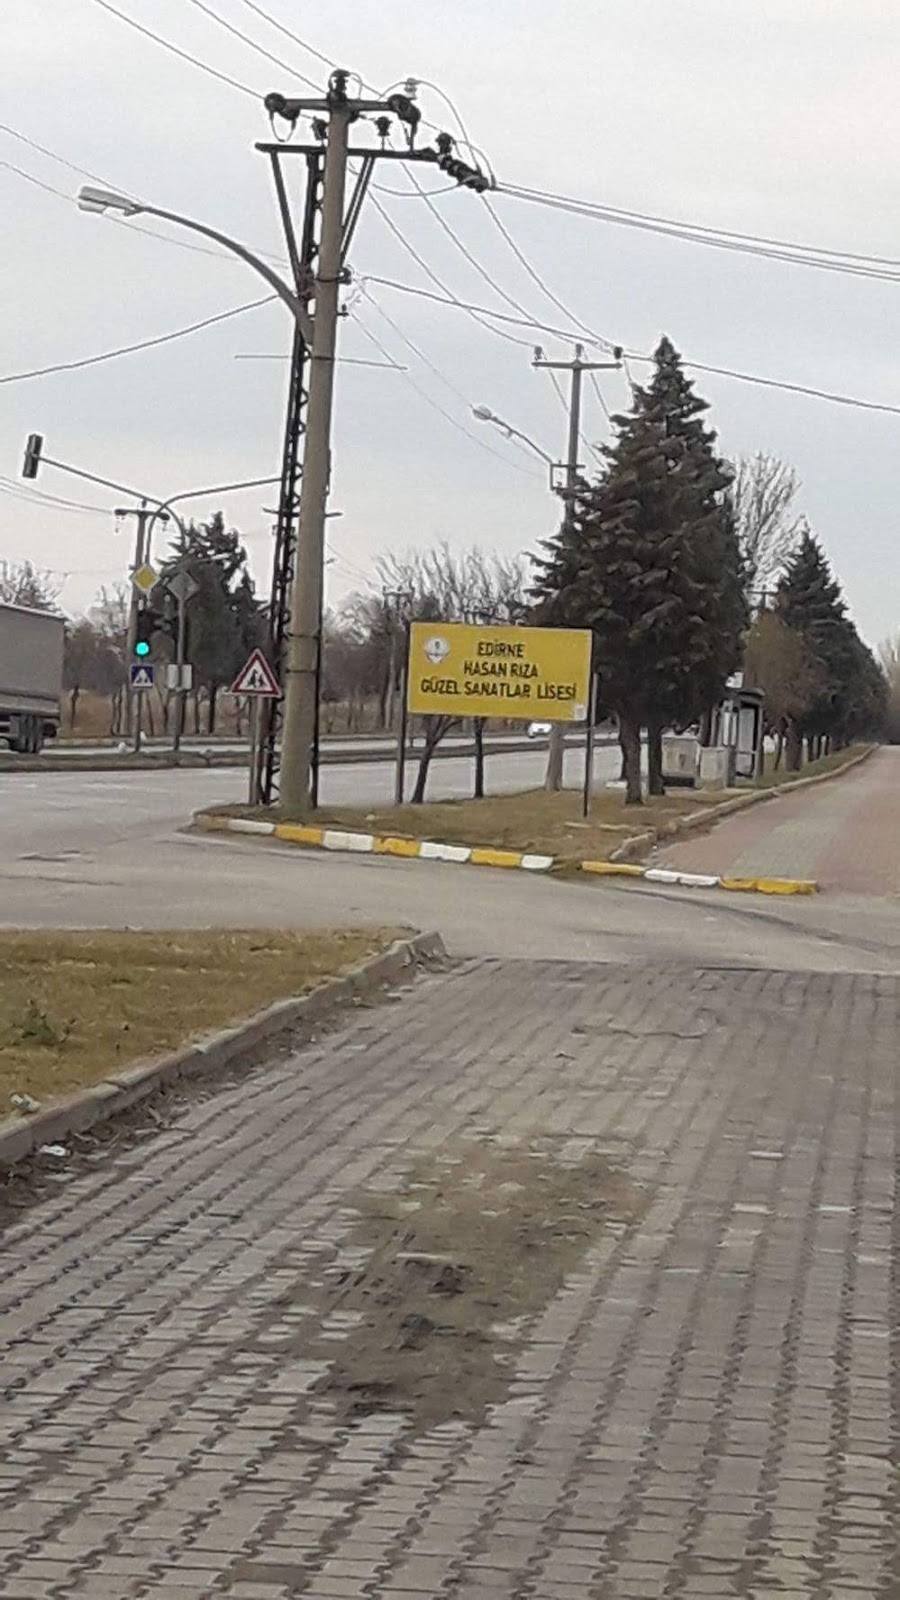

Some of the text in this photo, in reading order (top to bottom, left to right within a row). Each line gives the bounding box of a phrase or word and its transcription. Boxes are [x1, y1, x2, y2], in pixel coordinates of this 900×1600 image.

[477, 639, 525, 657] EDİRNE
[464, 661, 507, 678] HASAN
[421, 675, 460, 694] GÜZEL
[464, 681, 531, 698] SANATLAR
